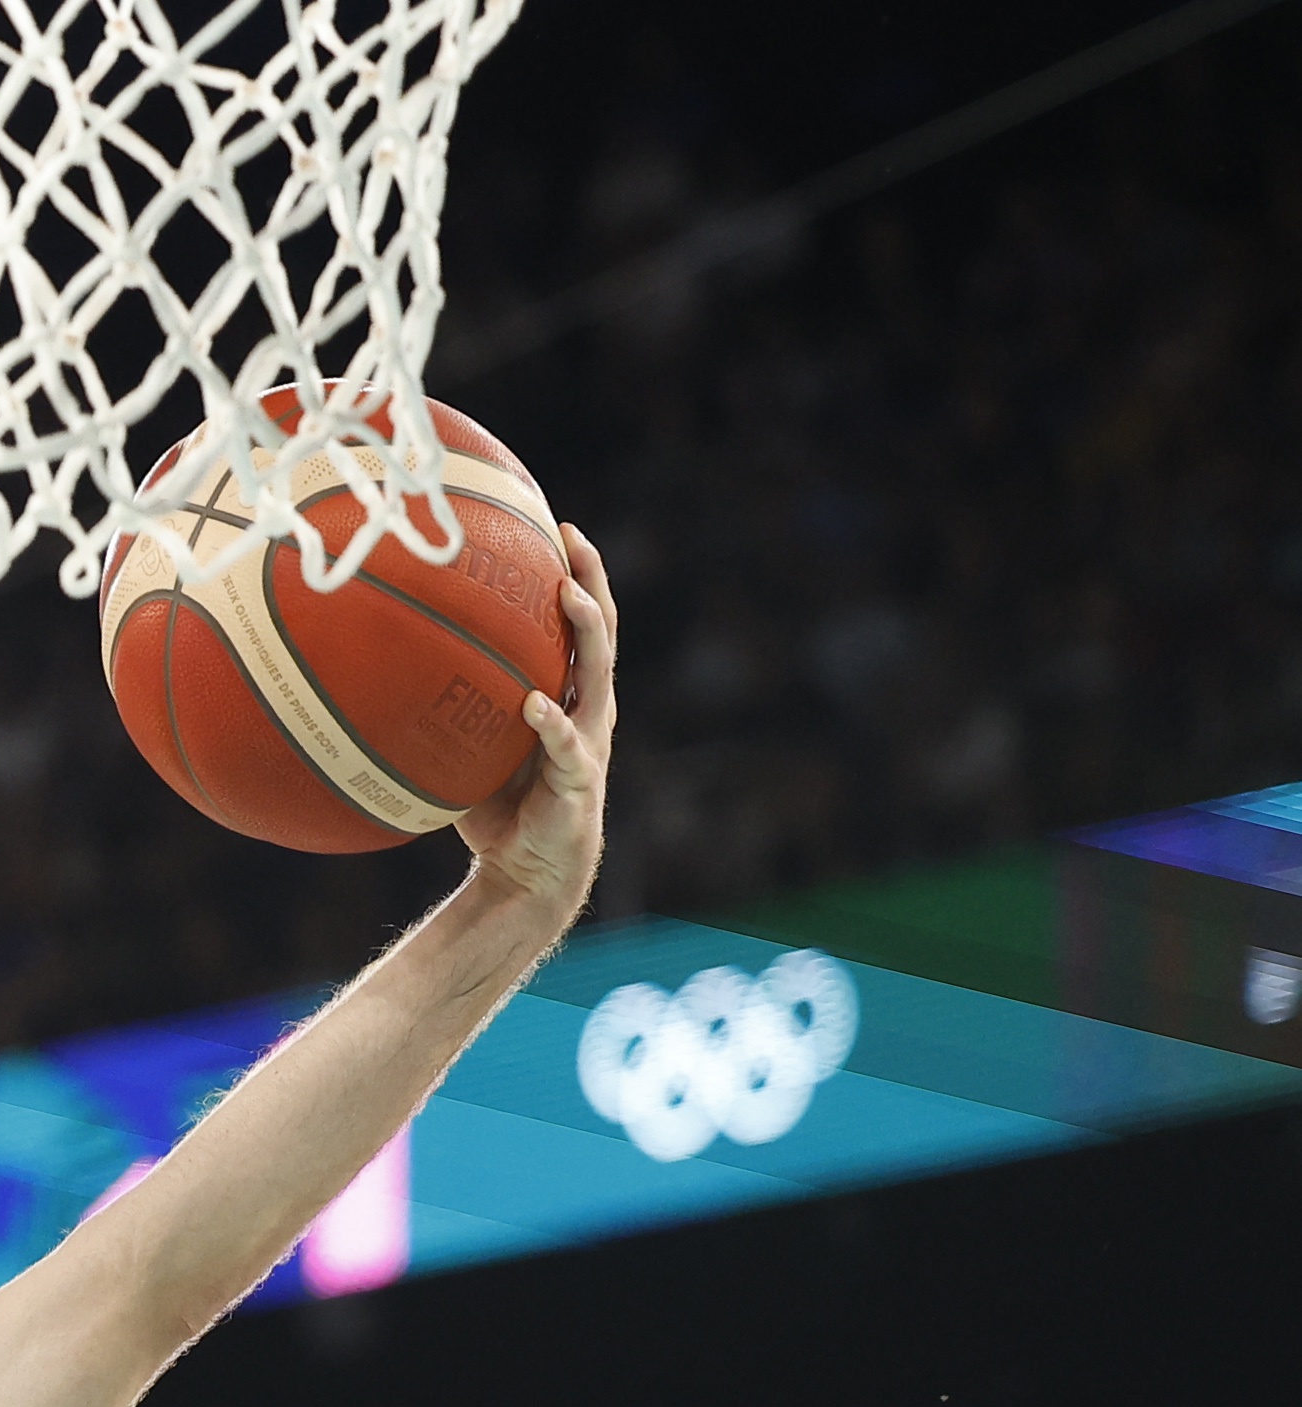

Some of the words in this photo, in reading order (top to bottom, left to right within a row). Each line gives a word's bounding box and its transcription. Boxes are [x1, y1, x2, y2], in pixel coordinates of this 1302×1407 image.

[221, 574, 241, 606] JEUX
[234, 602, 283, 684] OLYMPIQUES
[278, 681, 294, 699] DE
[289, 698, 317, 732] PARIS
[313, 730, 340, 760] 2024
[431, 673, 508, 748] FIBA
